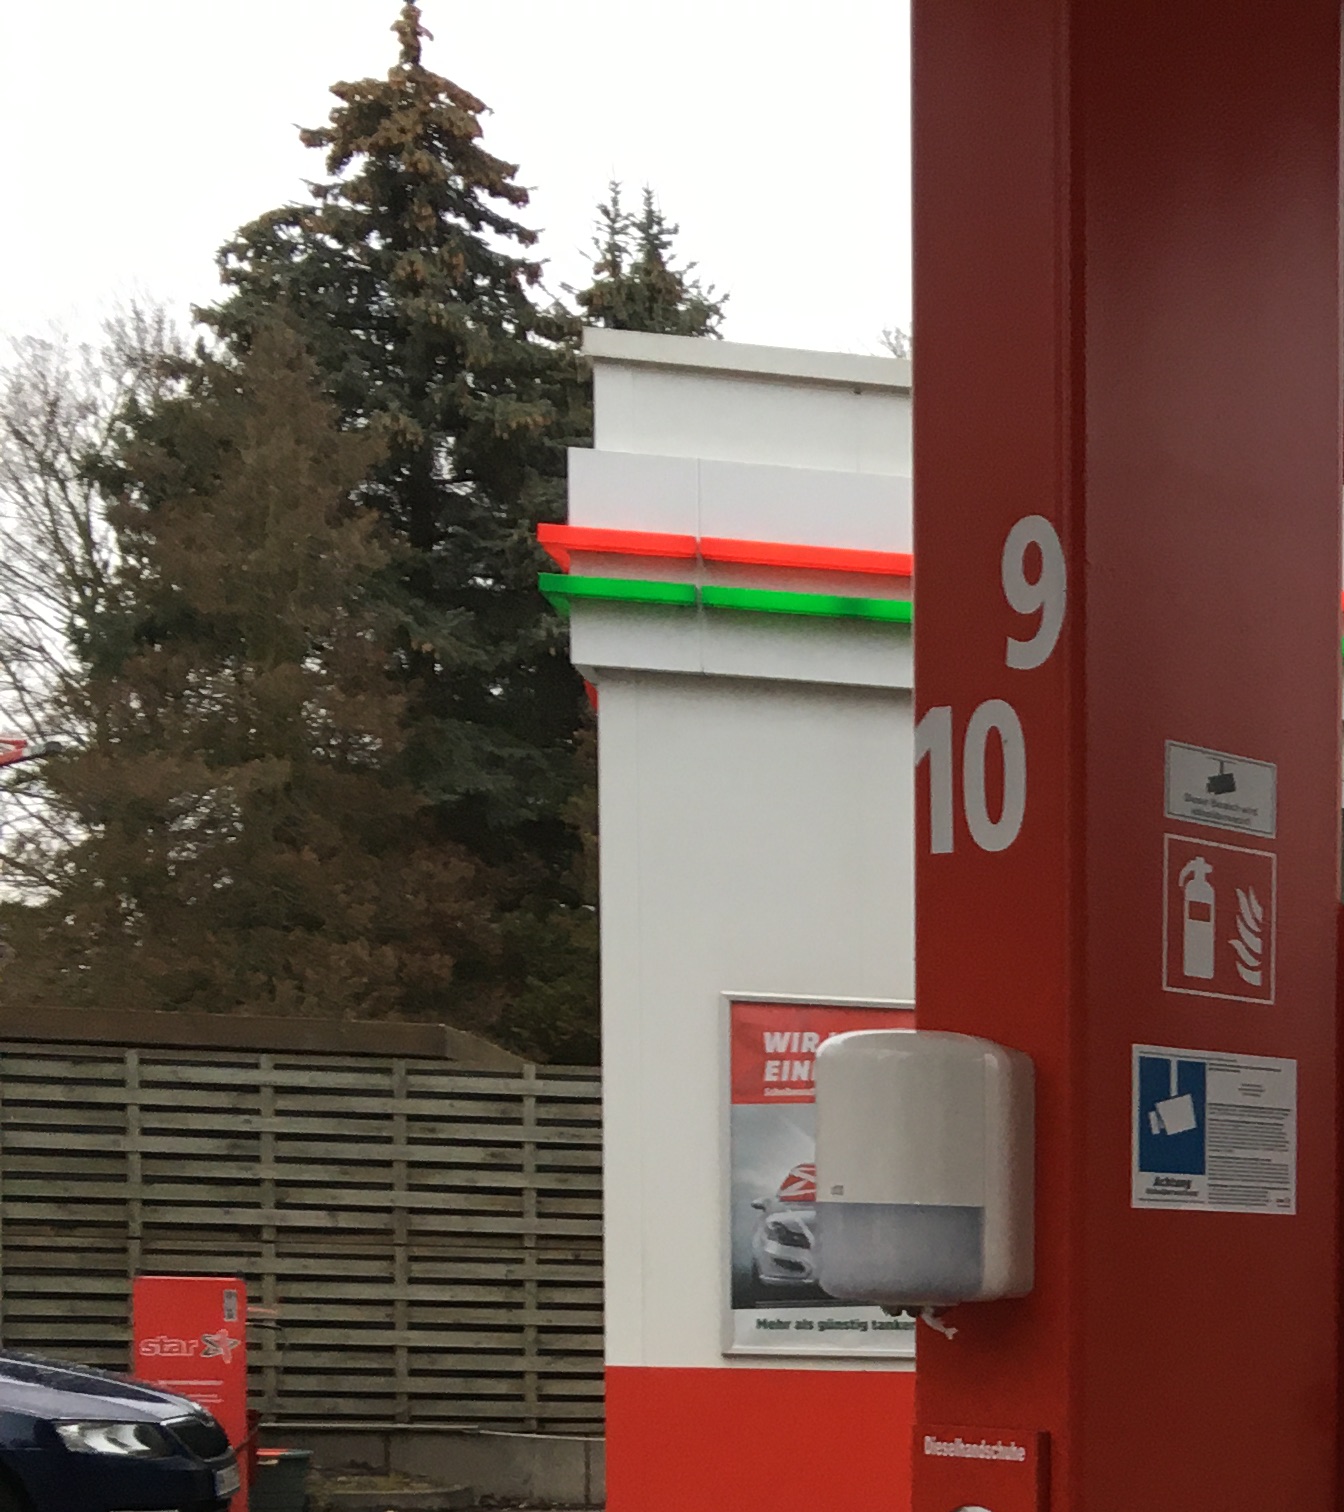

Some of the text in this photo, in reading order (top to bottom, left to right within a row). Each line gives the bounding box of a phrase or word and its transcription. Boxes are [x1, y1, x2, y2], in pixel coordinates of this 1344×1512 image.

[1002, 514, 1068, 670] 9
[914, 699, 1027, 855] 10
[763, 1031, 820, 1053] WIR
[139, 1335, 199, 1357] star
[924, 1435, 1026, 1462] Dieselhandschuhe
